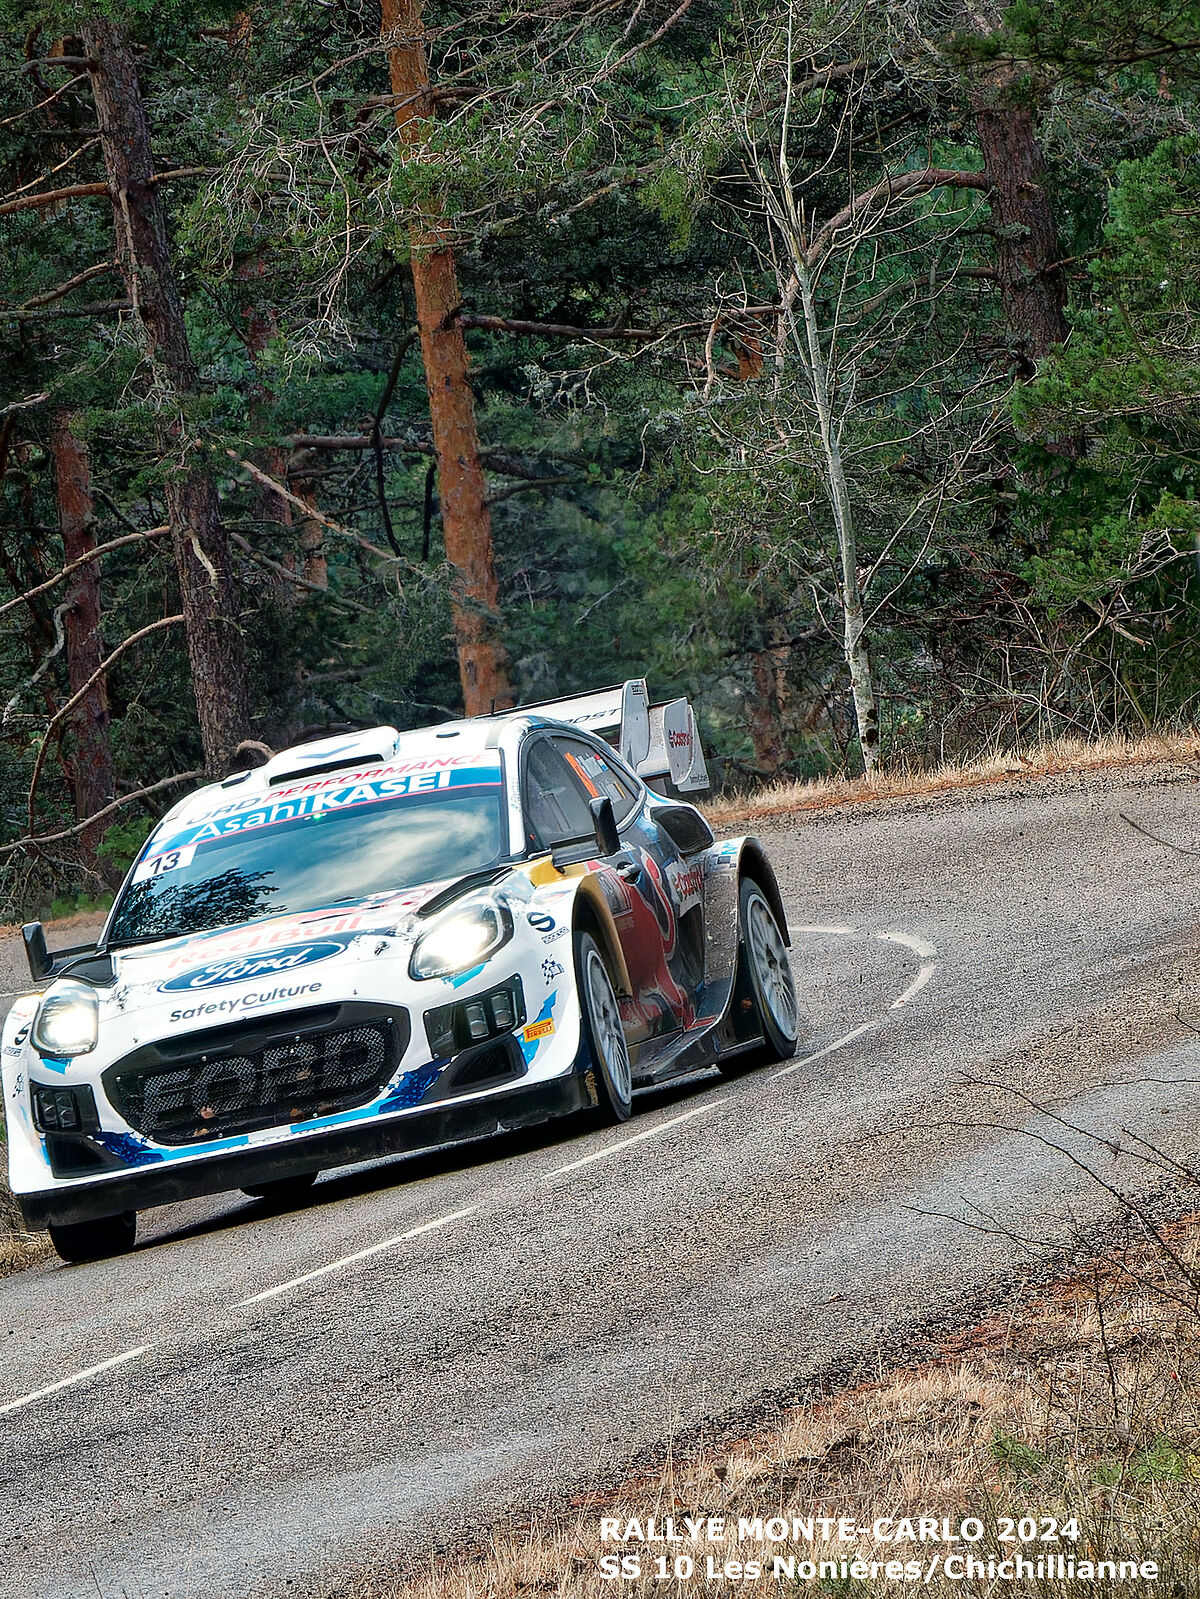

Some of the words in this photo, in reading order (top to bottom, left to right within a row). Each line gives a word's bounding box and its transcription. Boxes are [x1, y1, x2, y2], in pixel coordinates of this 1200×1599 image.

[262, 753, 490, 804] PERFORMANCE
[150, 851, 181, 875] 13
[167, 936, 261, 969] Red
[267, 916, 363, 944] Bull
[190, 947, 312, 988] Ford
[140, 1027, 386, 1131] FORD
